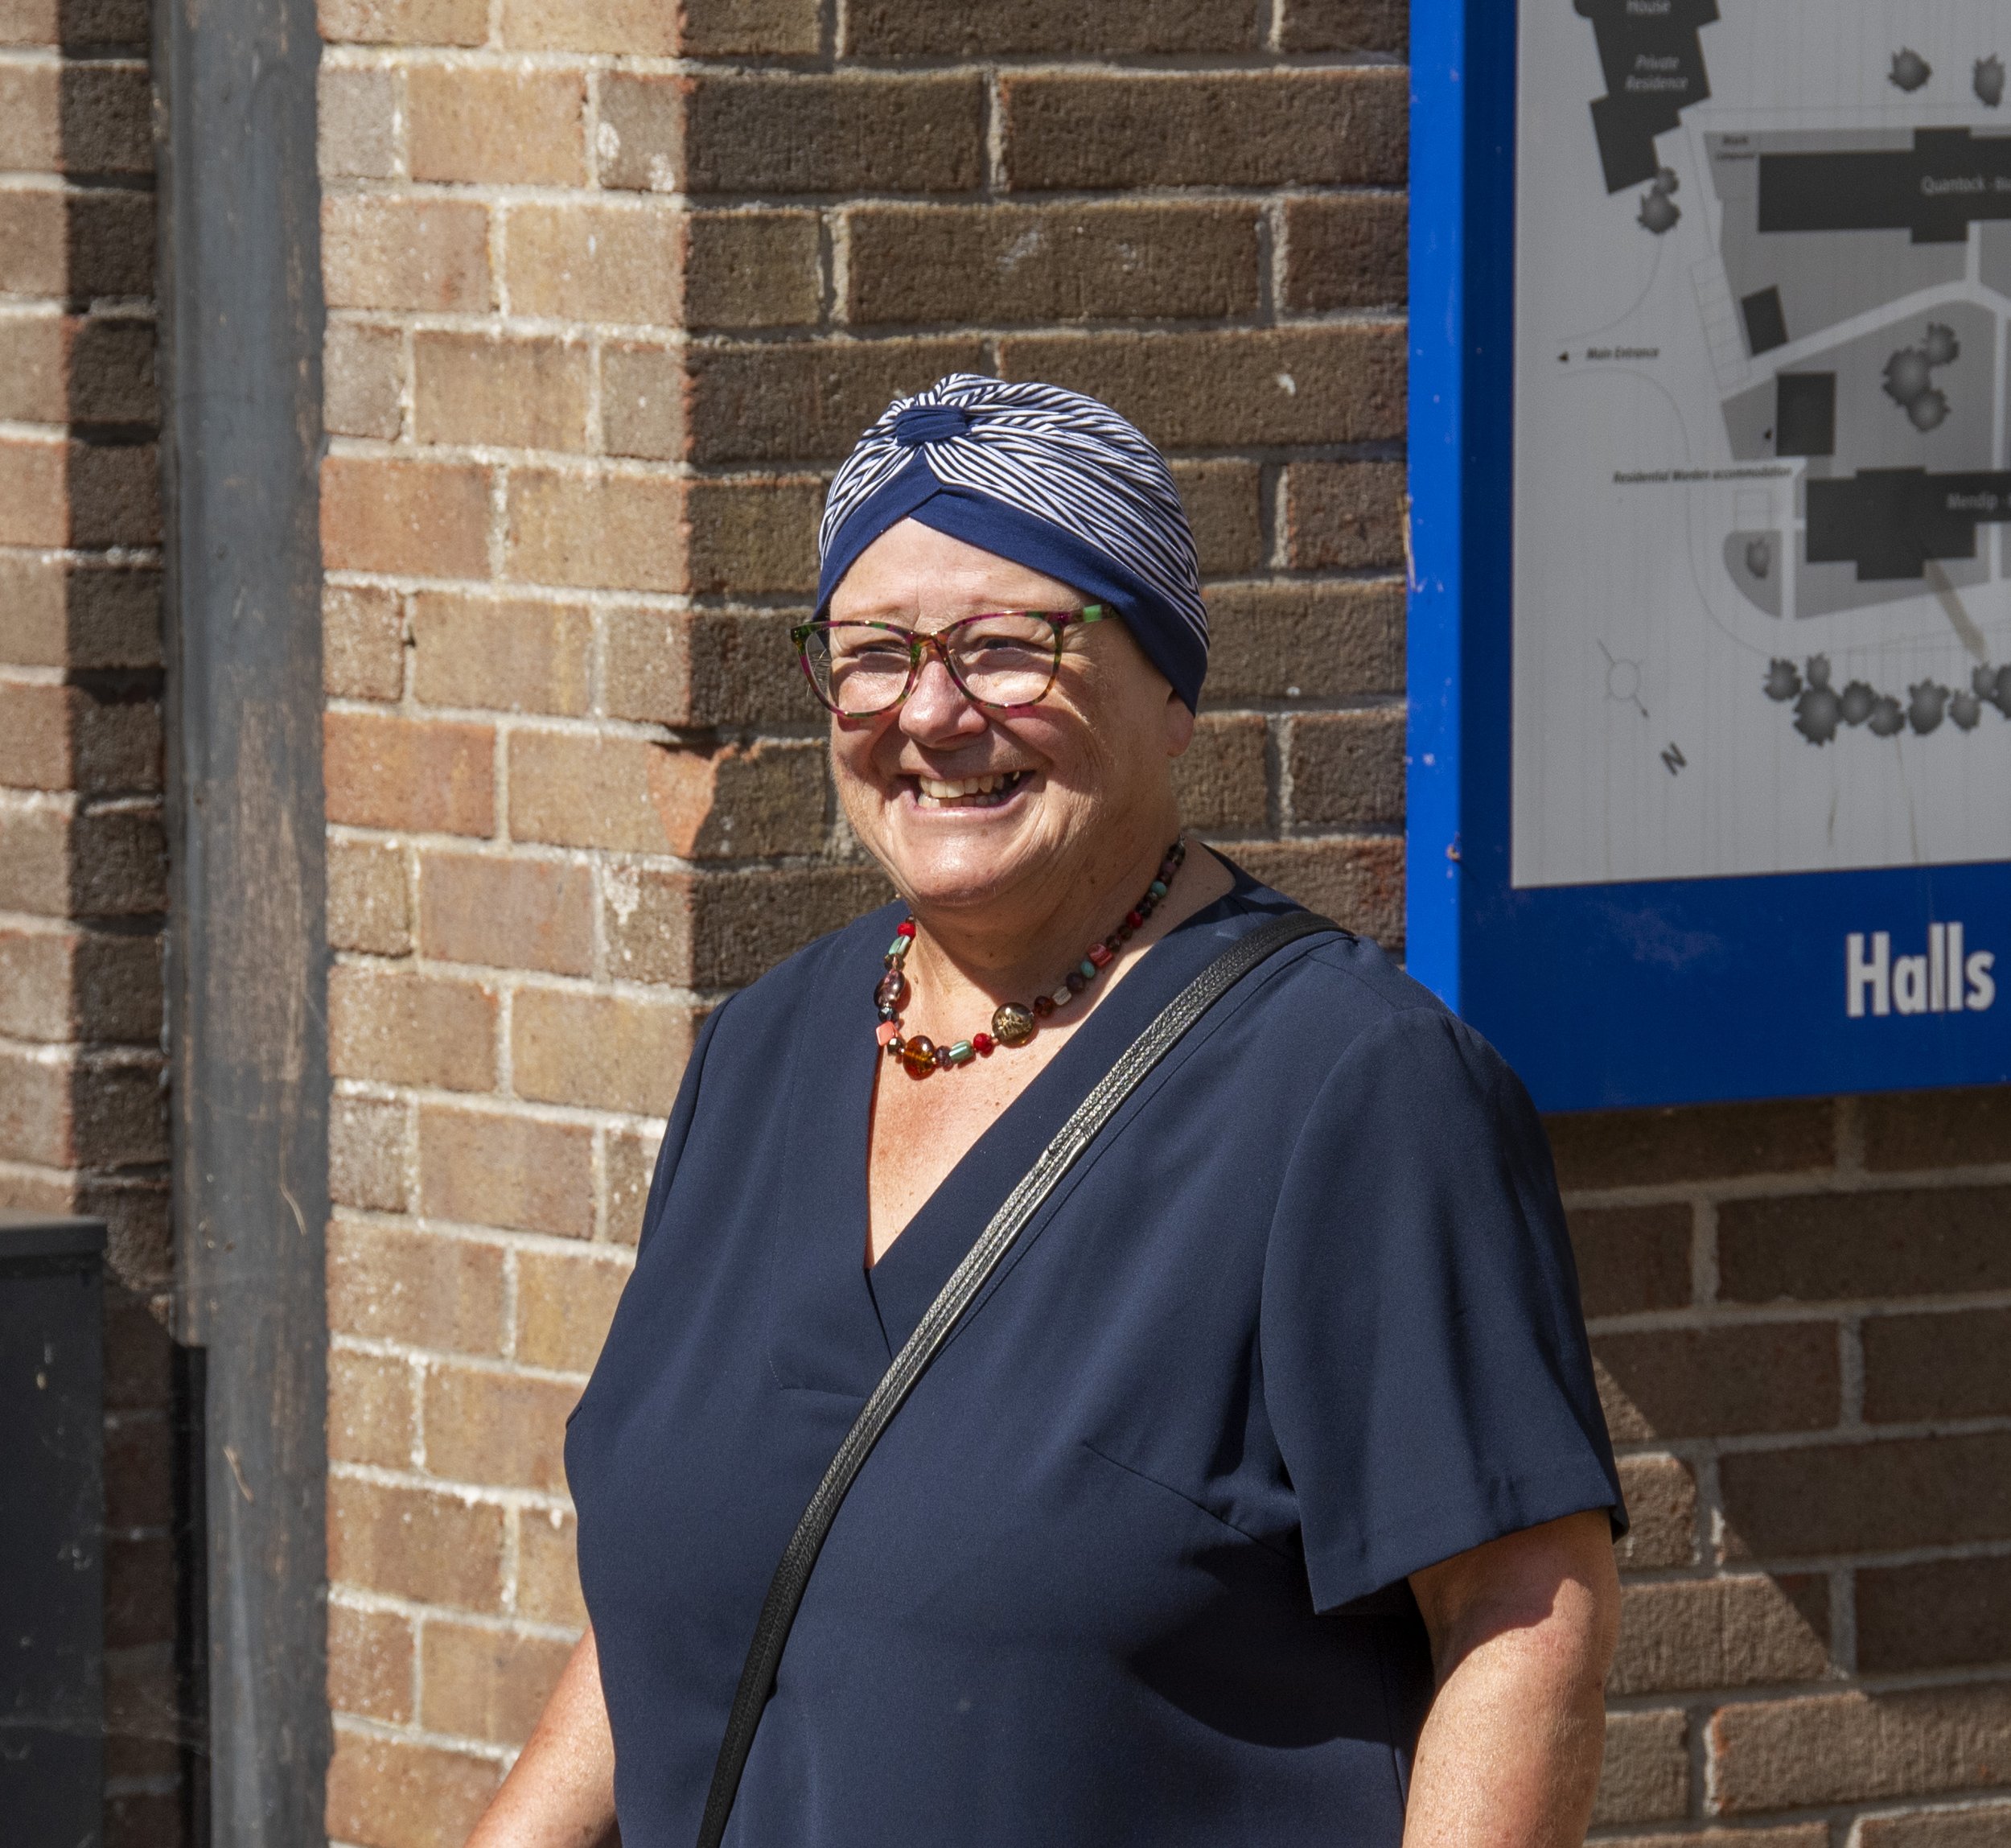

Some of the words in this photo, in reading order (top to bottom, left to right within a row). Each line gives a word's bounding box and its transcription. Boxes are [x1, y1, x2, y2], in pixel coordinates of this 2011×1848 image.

[1634, 54, 1680, 70] Private
[1625, 75, 1688, 92] Residence
[1921, 175, 1986, 195] Quantock
[1585, 347, 1611, 360] Main
[1614, 346, 1659, 360] Entrance
[1613, 470, 1669, 483] Residential
[1713, 466, 1793, 480] accommodation
[1660, 741, 1687, 776] N
[1845, 920, 1996, 1019] Halls
